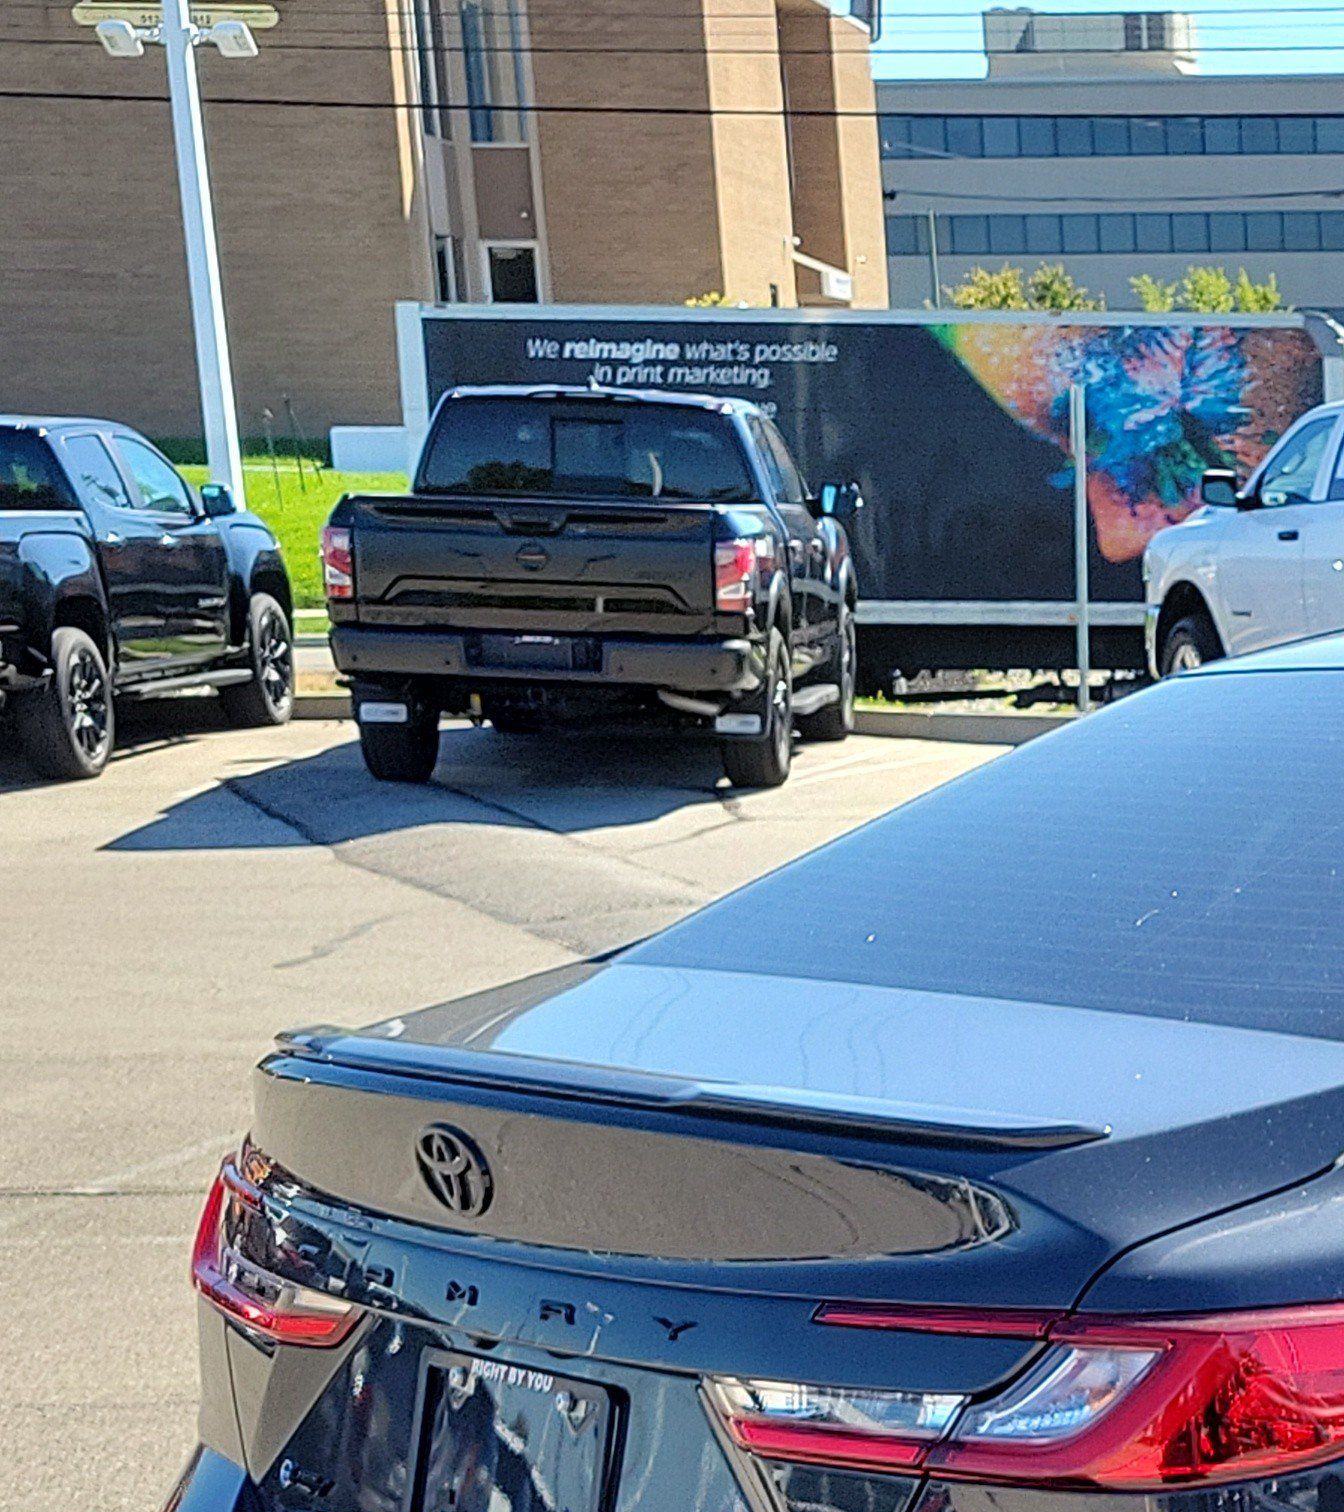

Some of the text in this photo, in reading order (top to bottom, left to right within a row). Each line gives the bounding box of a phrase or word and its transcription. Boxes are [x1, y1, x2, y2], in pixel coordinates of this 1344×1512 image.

[526, 338, 838, 363] We reimagine what's possible
[594, 361, 612, 381] in
[616, 363, 663, 385] print
[471, 1358, 555, 1394] RIGHT BY YOU
